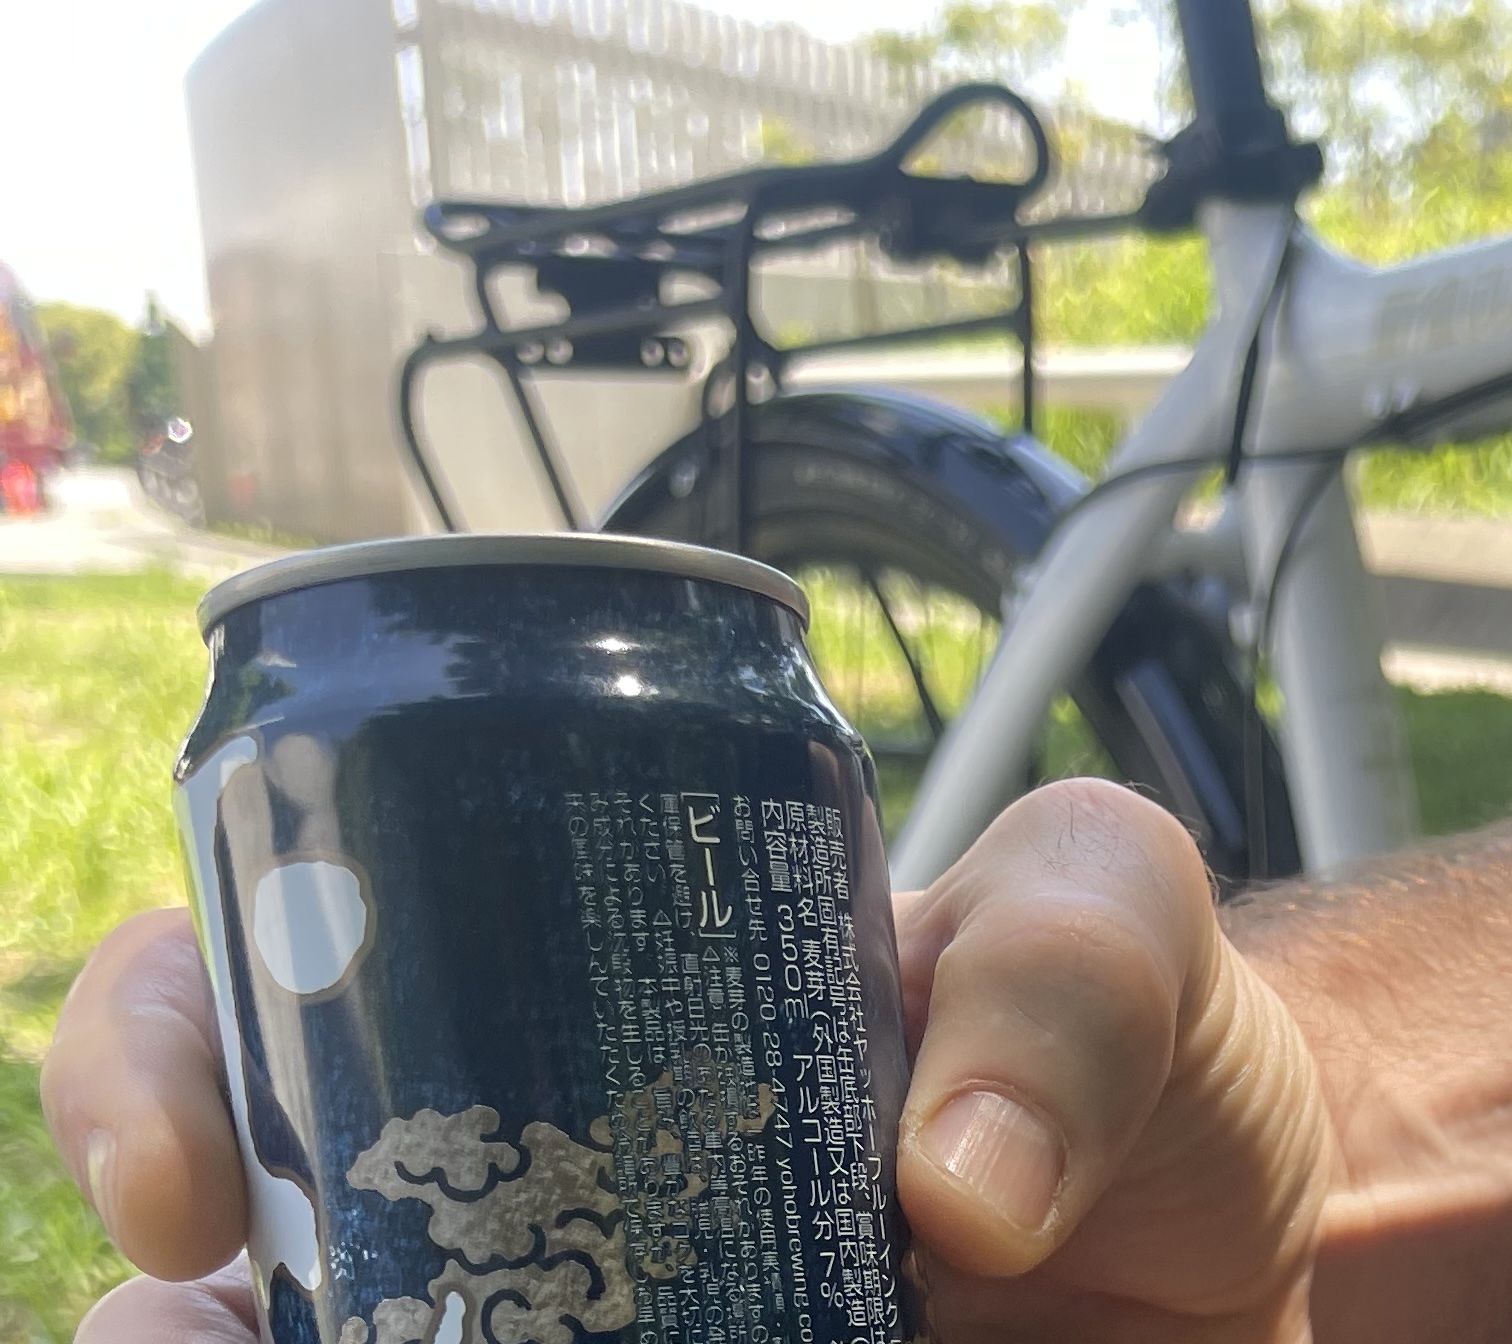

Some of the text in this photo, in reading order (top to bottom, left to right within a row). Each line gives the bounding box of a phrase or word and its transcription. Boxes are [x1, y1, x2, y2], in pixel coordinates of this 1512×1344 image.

[762, 798, 793, 892] 内容量
[785, 800, 818, 927] 原材料名
[825, 807, 849, 900] 販売者
[733, 795, 767, 941] お問い合せ先
[753, 953, 793, 1149] 0120-28-4747
[777, 904, 809, 1019] 350ml
